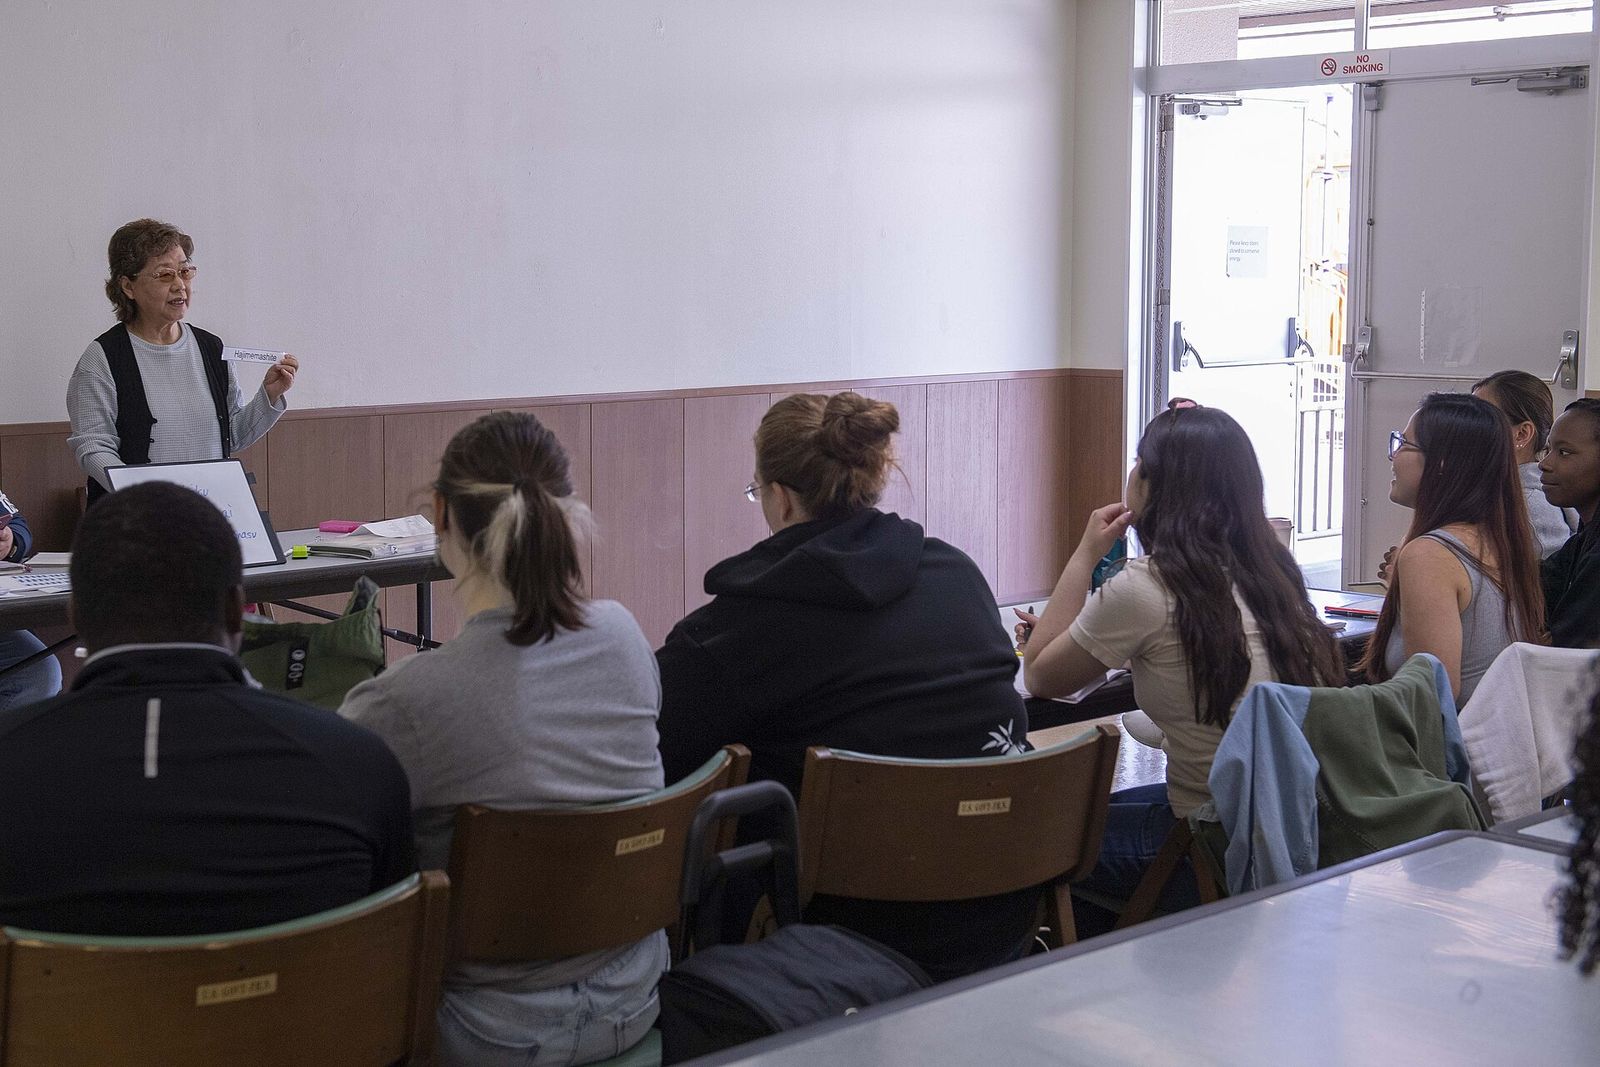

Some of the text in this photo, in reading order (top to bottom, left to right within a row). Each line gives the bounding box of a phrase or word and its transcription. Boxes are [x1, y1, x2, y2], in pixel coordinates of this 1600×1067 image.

[1356, 54, 1370, 63] NO
[1342, 63, 1384, 74] SMOKING
[234, 349, 278, 362] Hajimemashite
